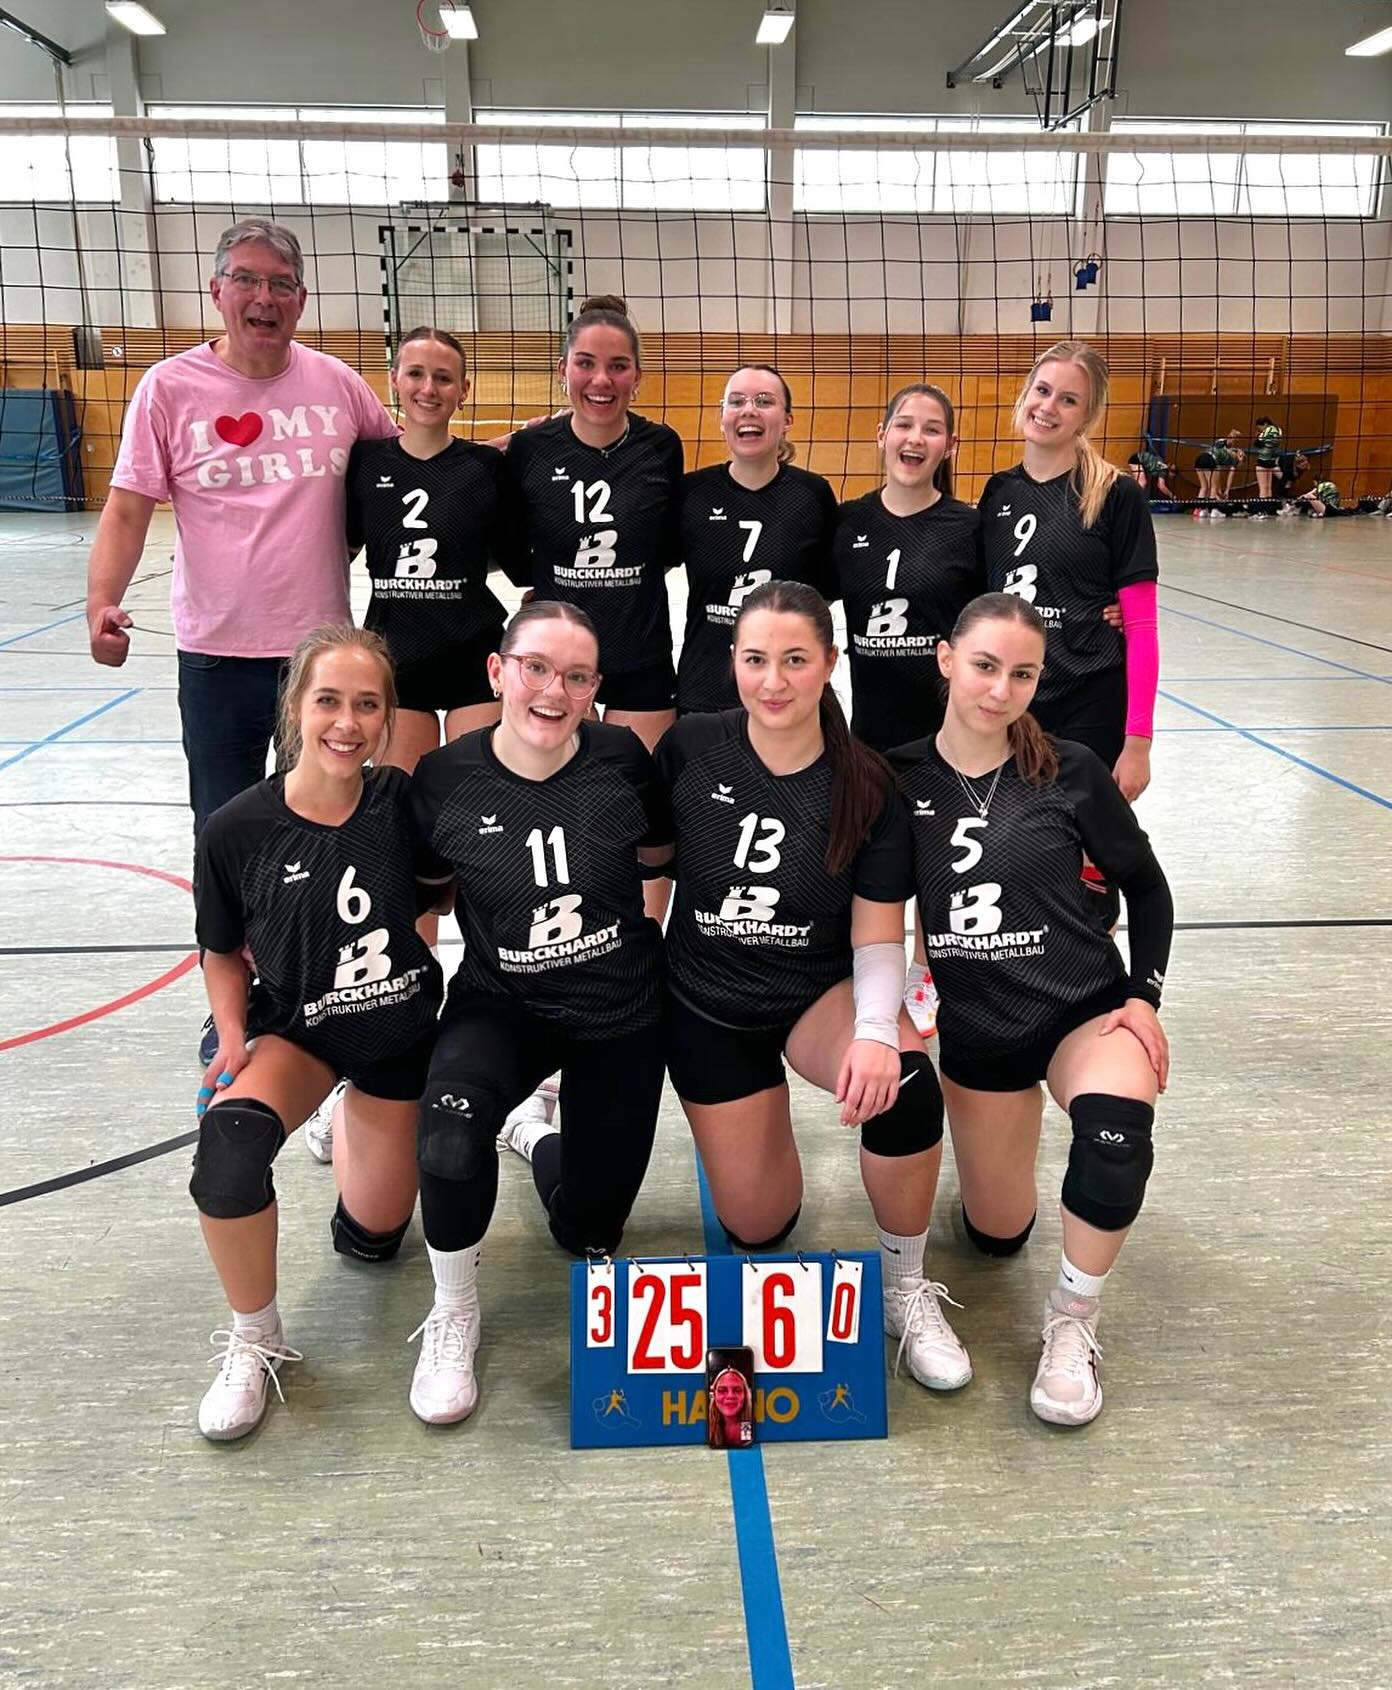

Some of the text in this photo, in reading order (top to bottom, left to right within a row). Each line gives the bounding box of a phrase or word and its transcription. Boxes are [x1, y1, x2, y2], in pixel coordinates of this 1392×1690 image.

[190, 405, 338, 453] I MY
[197, 448, 347, 488] GIRLS
[401, 487, 430, 529] 2
[570, 479, 615, 524] 12
[738, 520, 763, 563] 7
[1013, 513, 1037, 557] 9
[374, 578, 462, 590] BURCKHARDT
[553, 565, 642, 579] BURCKHARDT
[885, 547, 901, 591] 1
[525, 825, 570, 887] 11
[733, 812, 786, 874] 13
[950, 816, 989, 874] 5
[336, 865, 371, 925] 6
[498, 922, 619, 963] BURCKHARDT
[499, 938, 622, 974] KONSTRUKTIVER METALLBAU
[991, 944, 1045, 962] METALLBAU
[591, 1272, 856, 1370] 3 25 6 0
